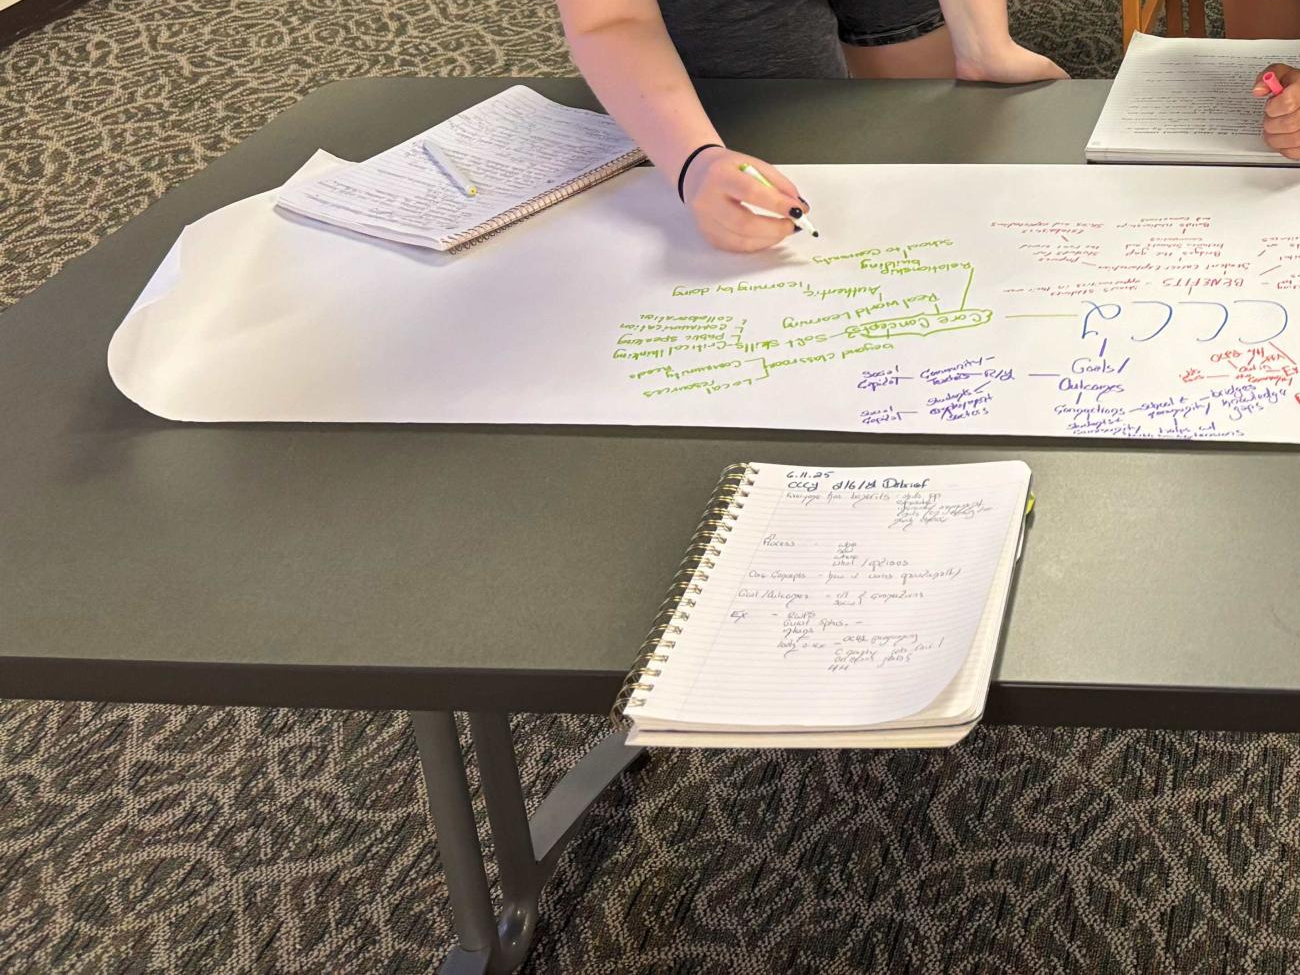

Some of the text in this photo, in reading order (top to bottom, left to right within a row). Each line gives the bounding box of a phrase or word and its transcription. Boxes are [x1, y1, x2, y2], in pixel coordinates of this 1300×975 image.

[716, 283, 734, 294] by
[1162, 278, 1245, 289] BENEFITS
[671, 285, 710, 298] doing
[802, 285, 881, 301] Authentic
[902, 293, 939, 310] Real
[853, 313, 982, 339] Core Concepts
[705, 378, 752, 396] Local
[1058, 377, 1127, 403] Outcomes
[786, 470, 834, 480] 6.11.25
[881, 477, 931, 490] Debrief
